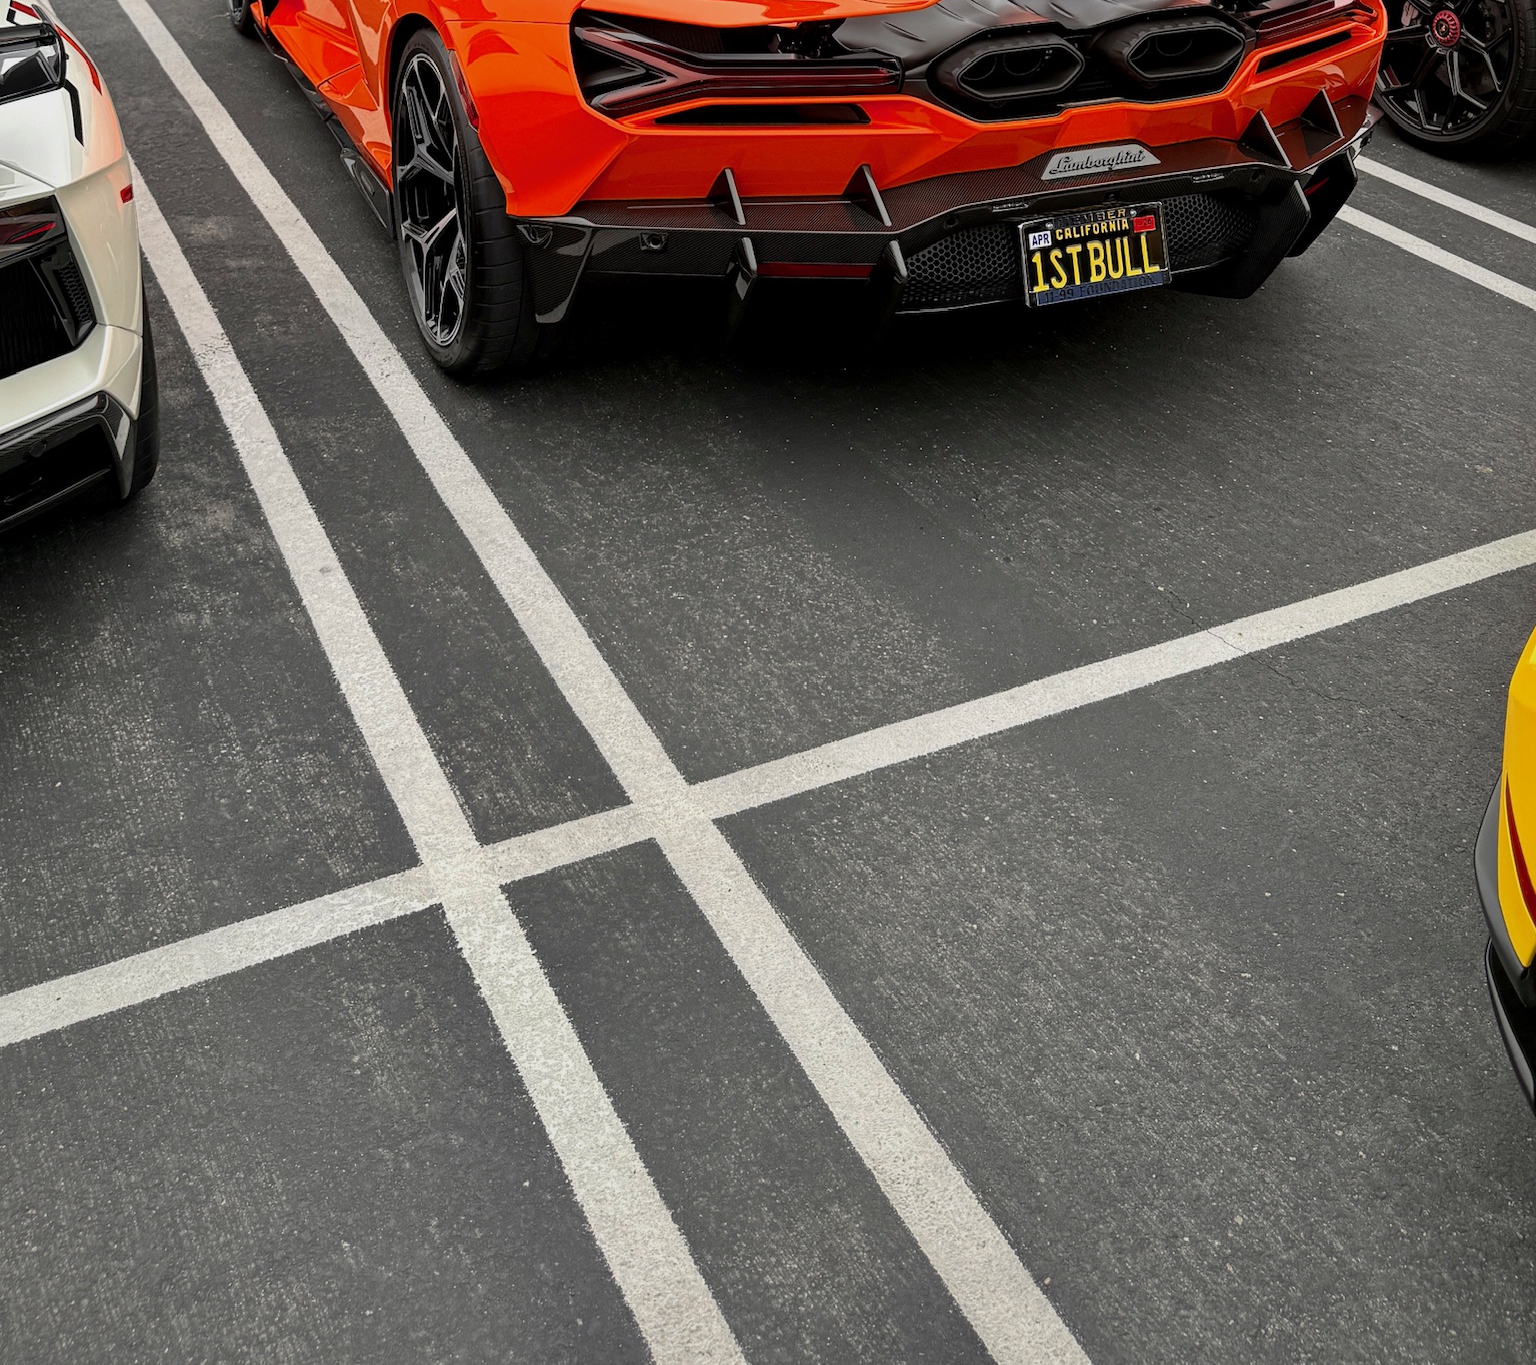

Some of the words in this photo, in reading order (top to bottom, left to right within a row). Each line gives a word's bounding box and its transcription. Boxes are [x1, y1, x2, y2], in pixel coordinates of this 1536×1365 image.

[1049, 148, 1146, 175] Lamborghini
[1032, 233, 1050, 246] APR
[1055, 218, 1129, 241] CALIFORNIA
[1031, 233, 1160, 293] 1STBULL
[1044, 288, 1075, 304] 11-99
[1080, 275, 1157, 299] FOUNDATION
